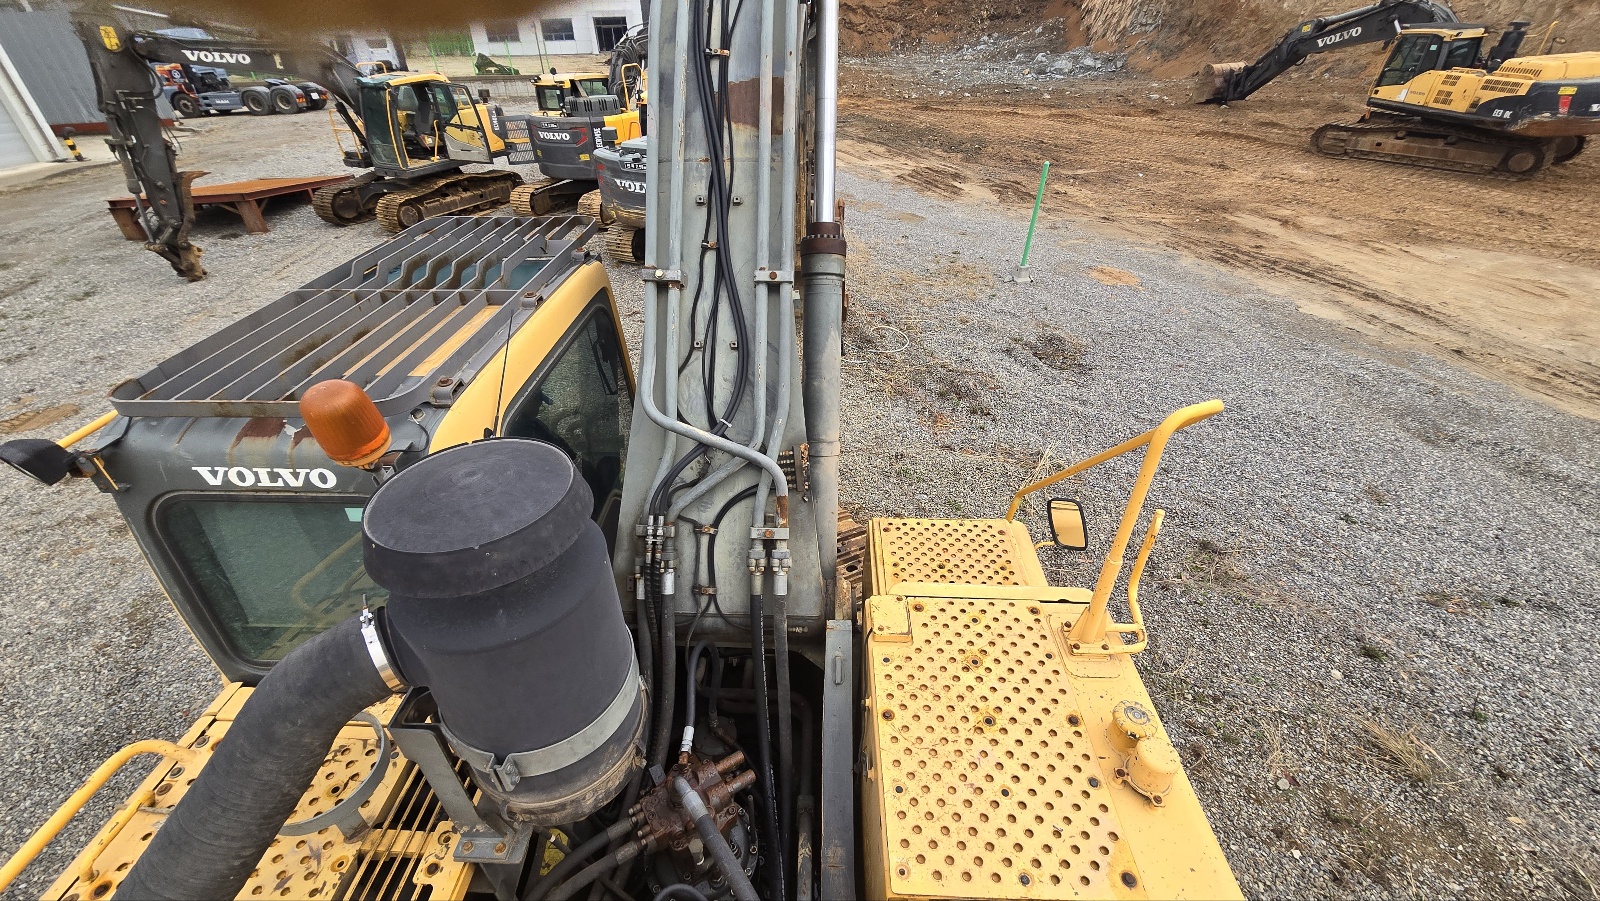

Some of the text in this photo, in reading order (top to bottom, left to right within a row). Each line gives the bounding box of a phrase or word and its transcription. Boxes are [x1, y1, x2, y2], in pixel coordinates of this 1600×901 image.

[1317, 26, 1362, 47] VOLVO
[181, 50, 251, 64] VOLVO
[538, 131, 570, 140] VOLVO
[614, 178, 647, 194] VOL
[192, 466, 337, 489] VOLVO
